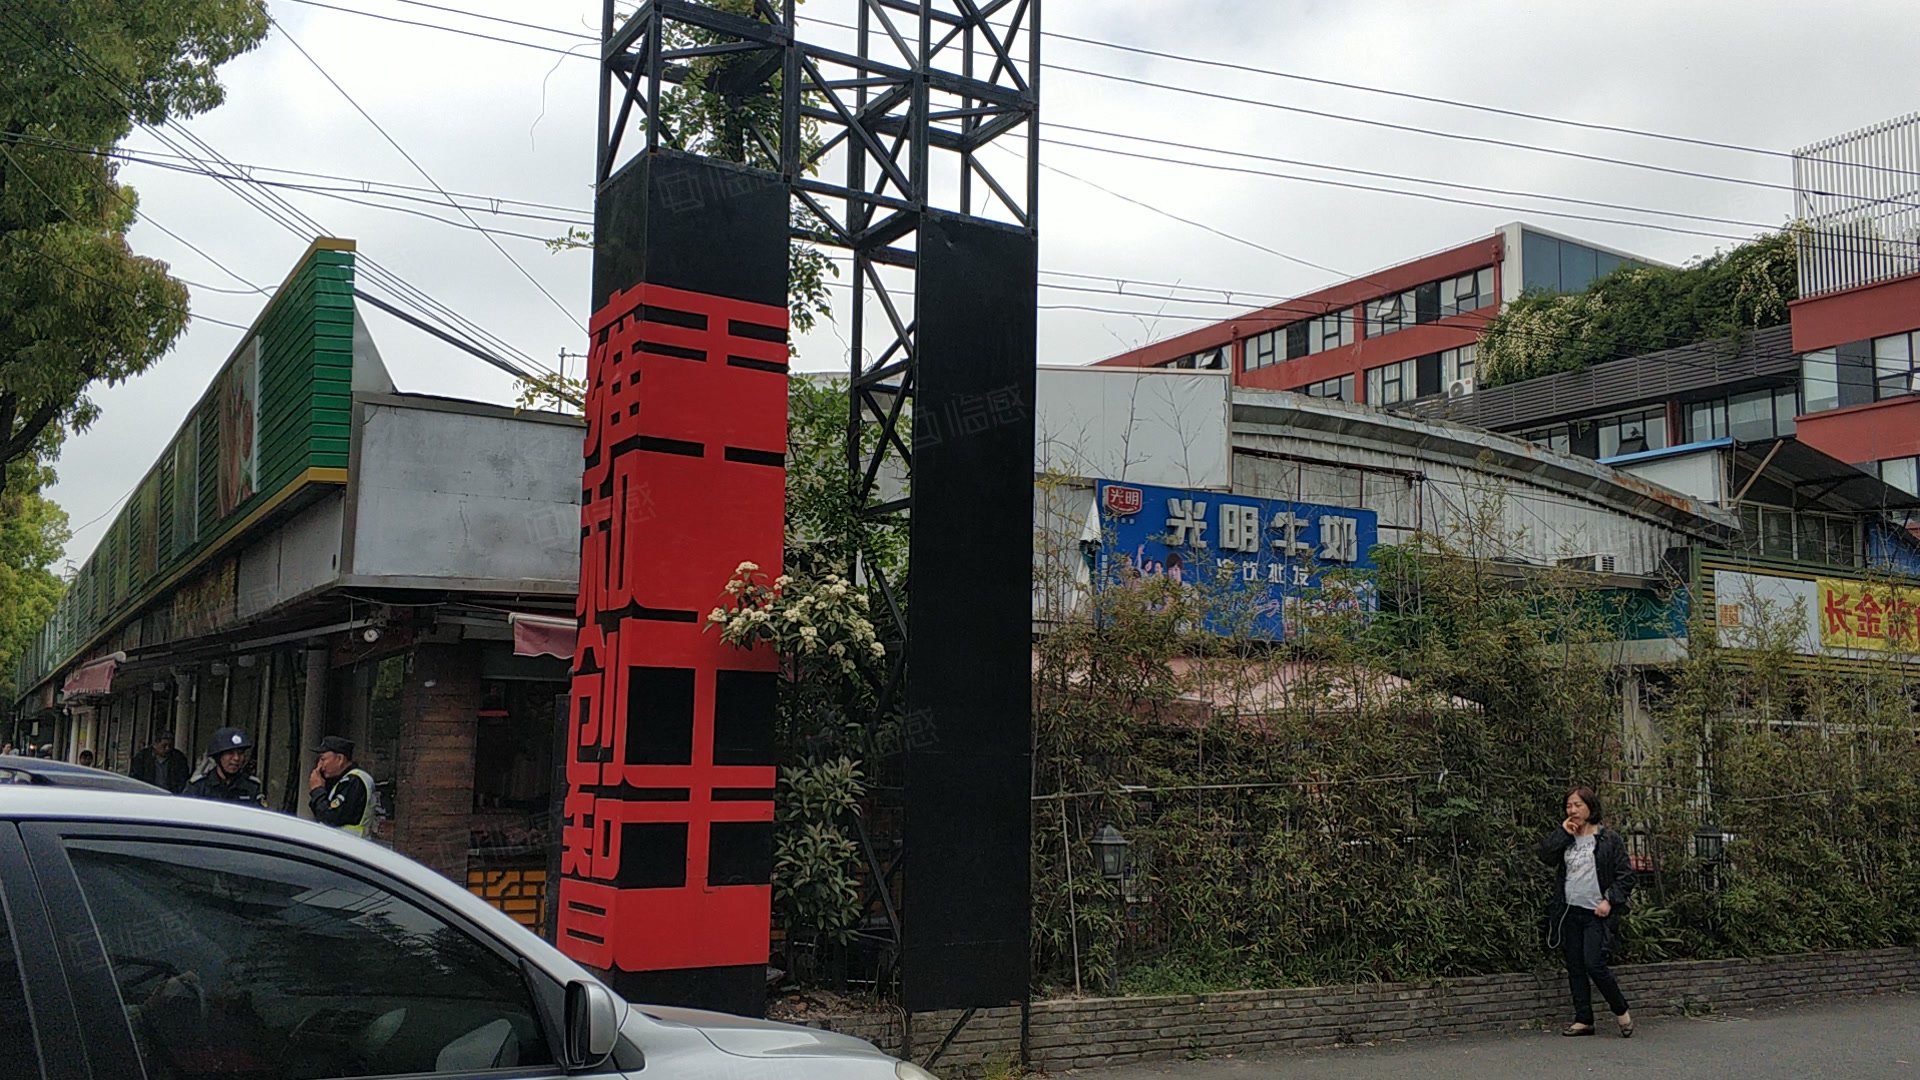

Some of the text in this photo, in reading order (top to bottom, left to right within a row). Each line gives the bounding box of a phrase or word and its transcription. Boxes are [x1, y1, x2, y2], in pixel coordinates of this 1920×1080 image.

[1110, 488, 1139, 505] 光明
[1166, 497, 1358, 563] 光明牛奶
[1825, 589, 1920, 644] 长金饮
